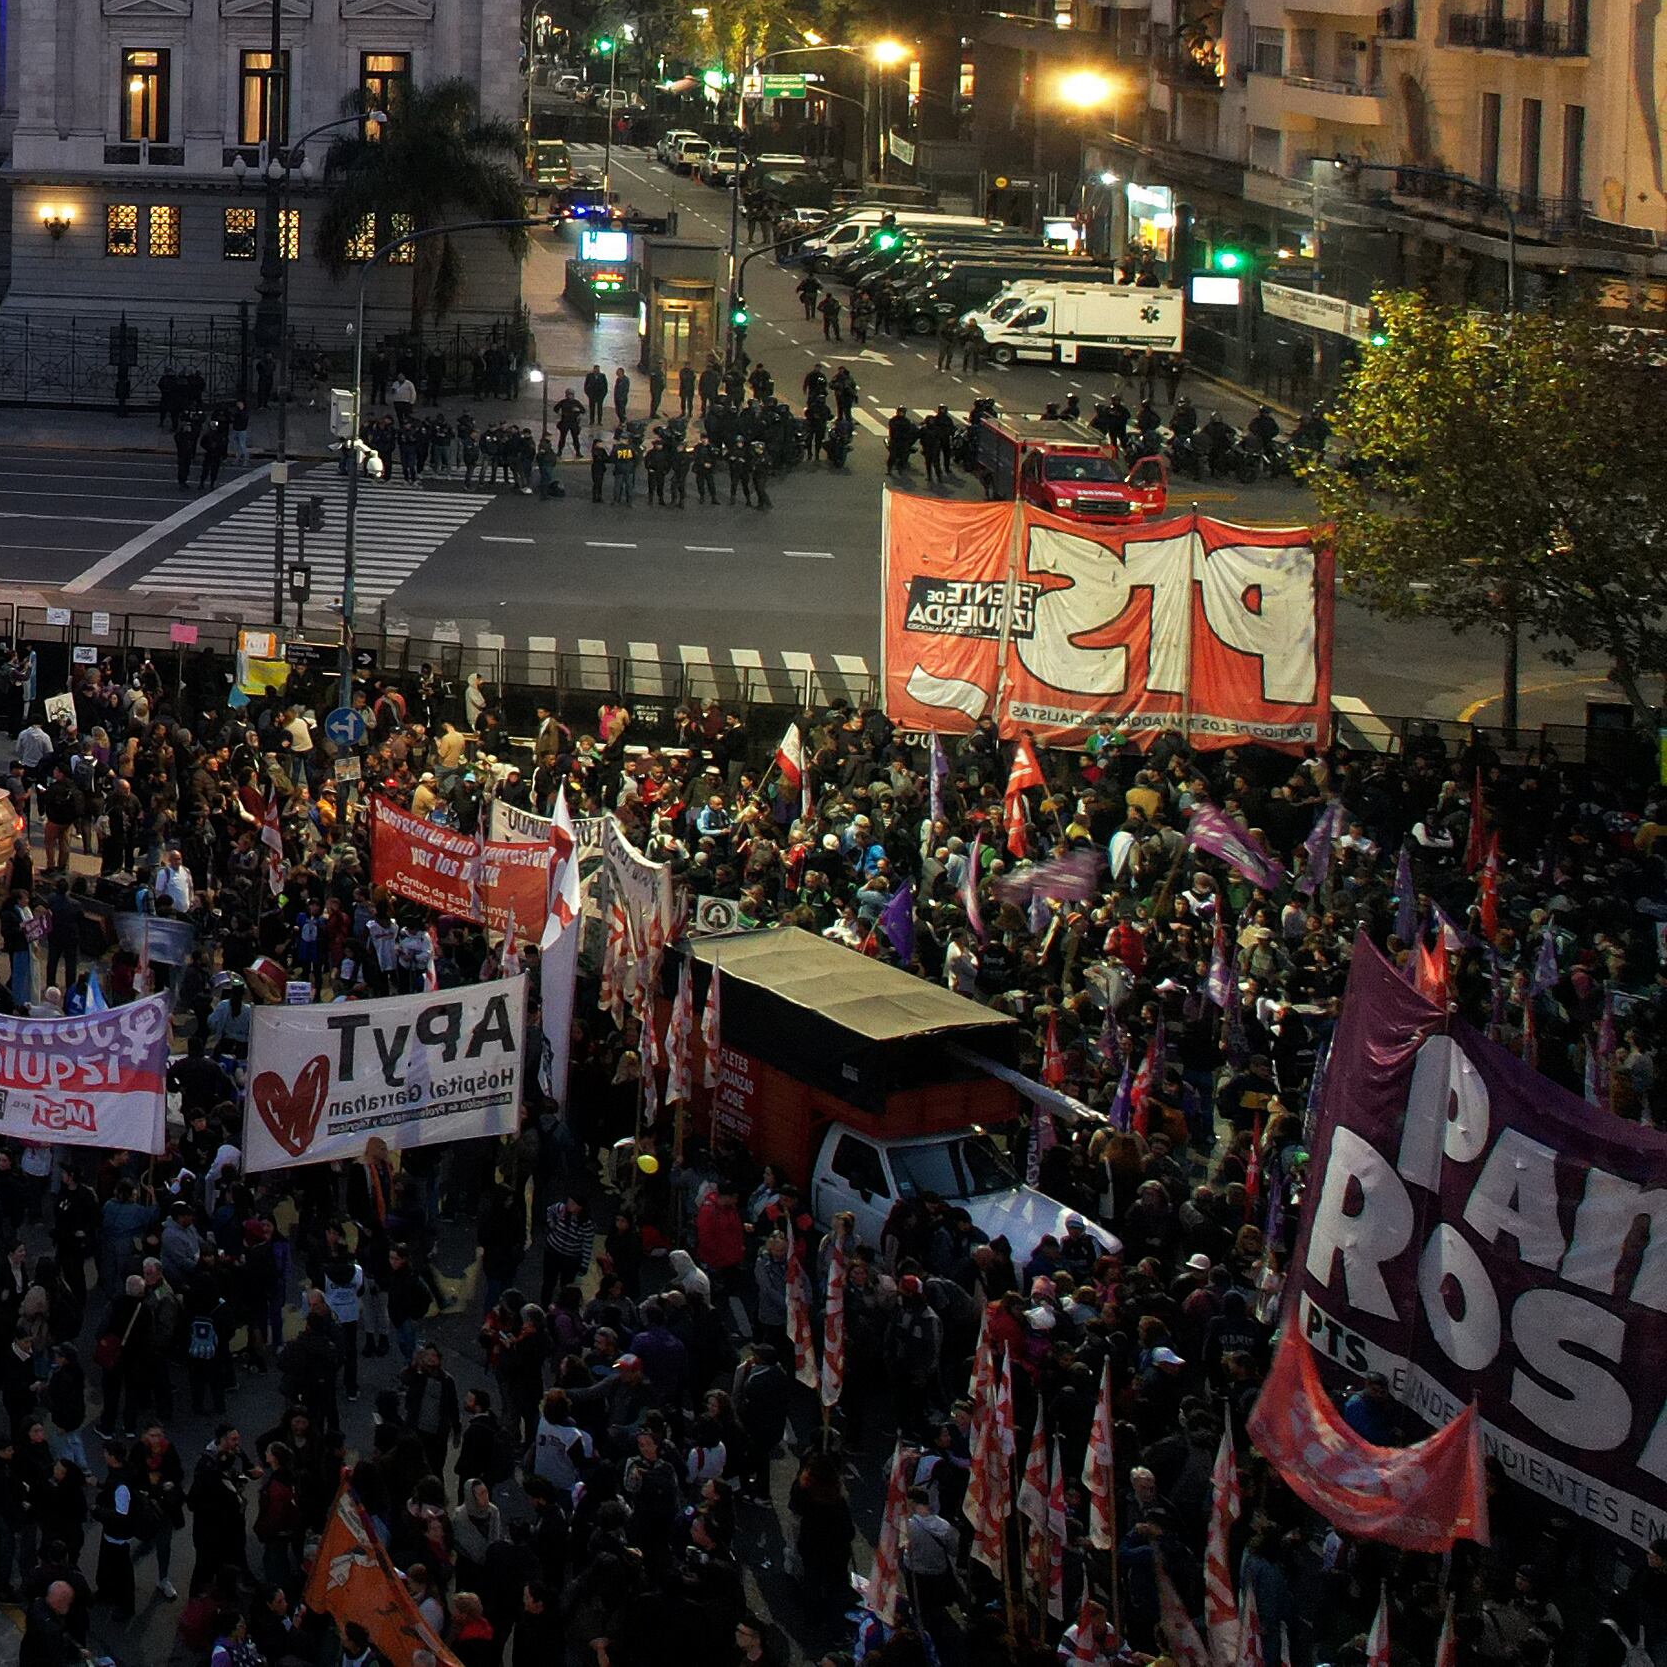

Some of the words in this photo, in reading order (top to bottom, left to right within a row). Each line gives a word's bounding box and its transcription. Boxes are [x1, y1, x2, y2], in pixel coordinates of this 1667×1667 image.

[617, 449, 633, 459] PFA
[411, 846, 432, 870] por
[435, 851, 460, 877] los
[386, 879, 399, 892] de
[401, 884, 444, 909] Ciencias
[396, 871, 430, 893] Centro
[431, 887, 446, 900] de
